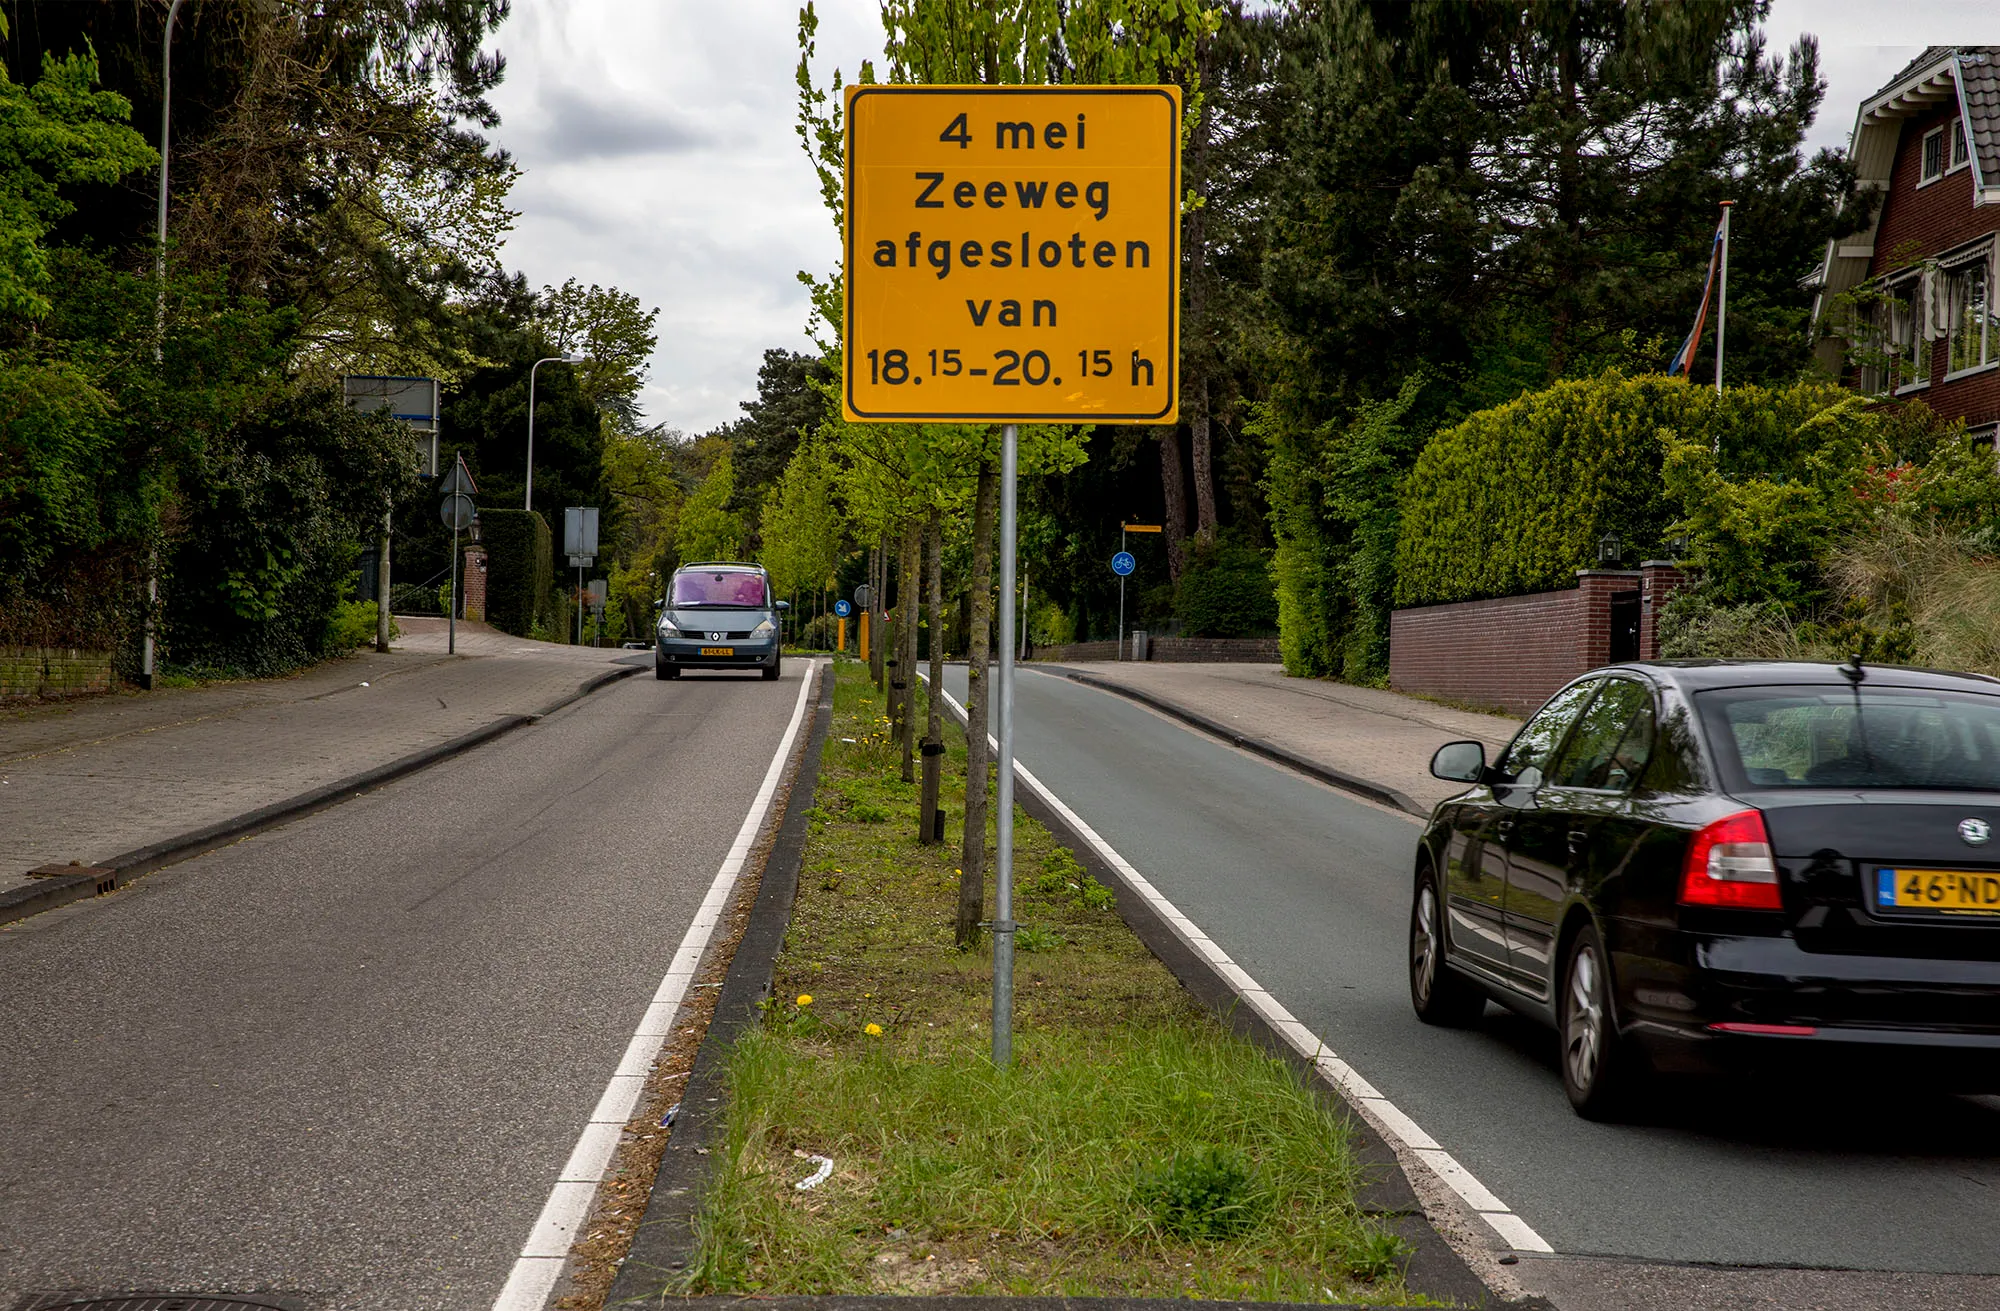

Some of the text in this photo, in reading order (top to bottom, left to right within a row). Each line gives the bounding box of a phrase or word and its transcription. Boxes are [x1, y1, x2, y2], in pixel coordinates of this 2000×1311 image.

[939, 112, 1086, 150] 4 mei
[914, 171, 1109, 222] Zeeweg
[873, 231, 1150, 280] afgesloten
[965, 299, 1057, 327] van
[1131, 349, 1154, 386] h
